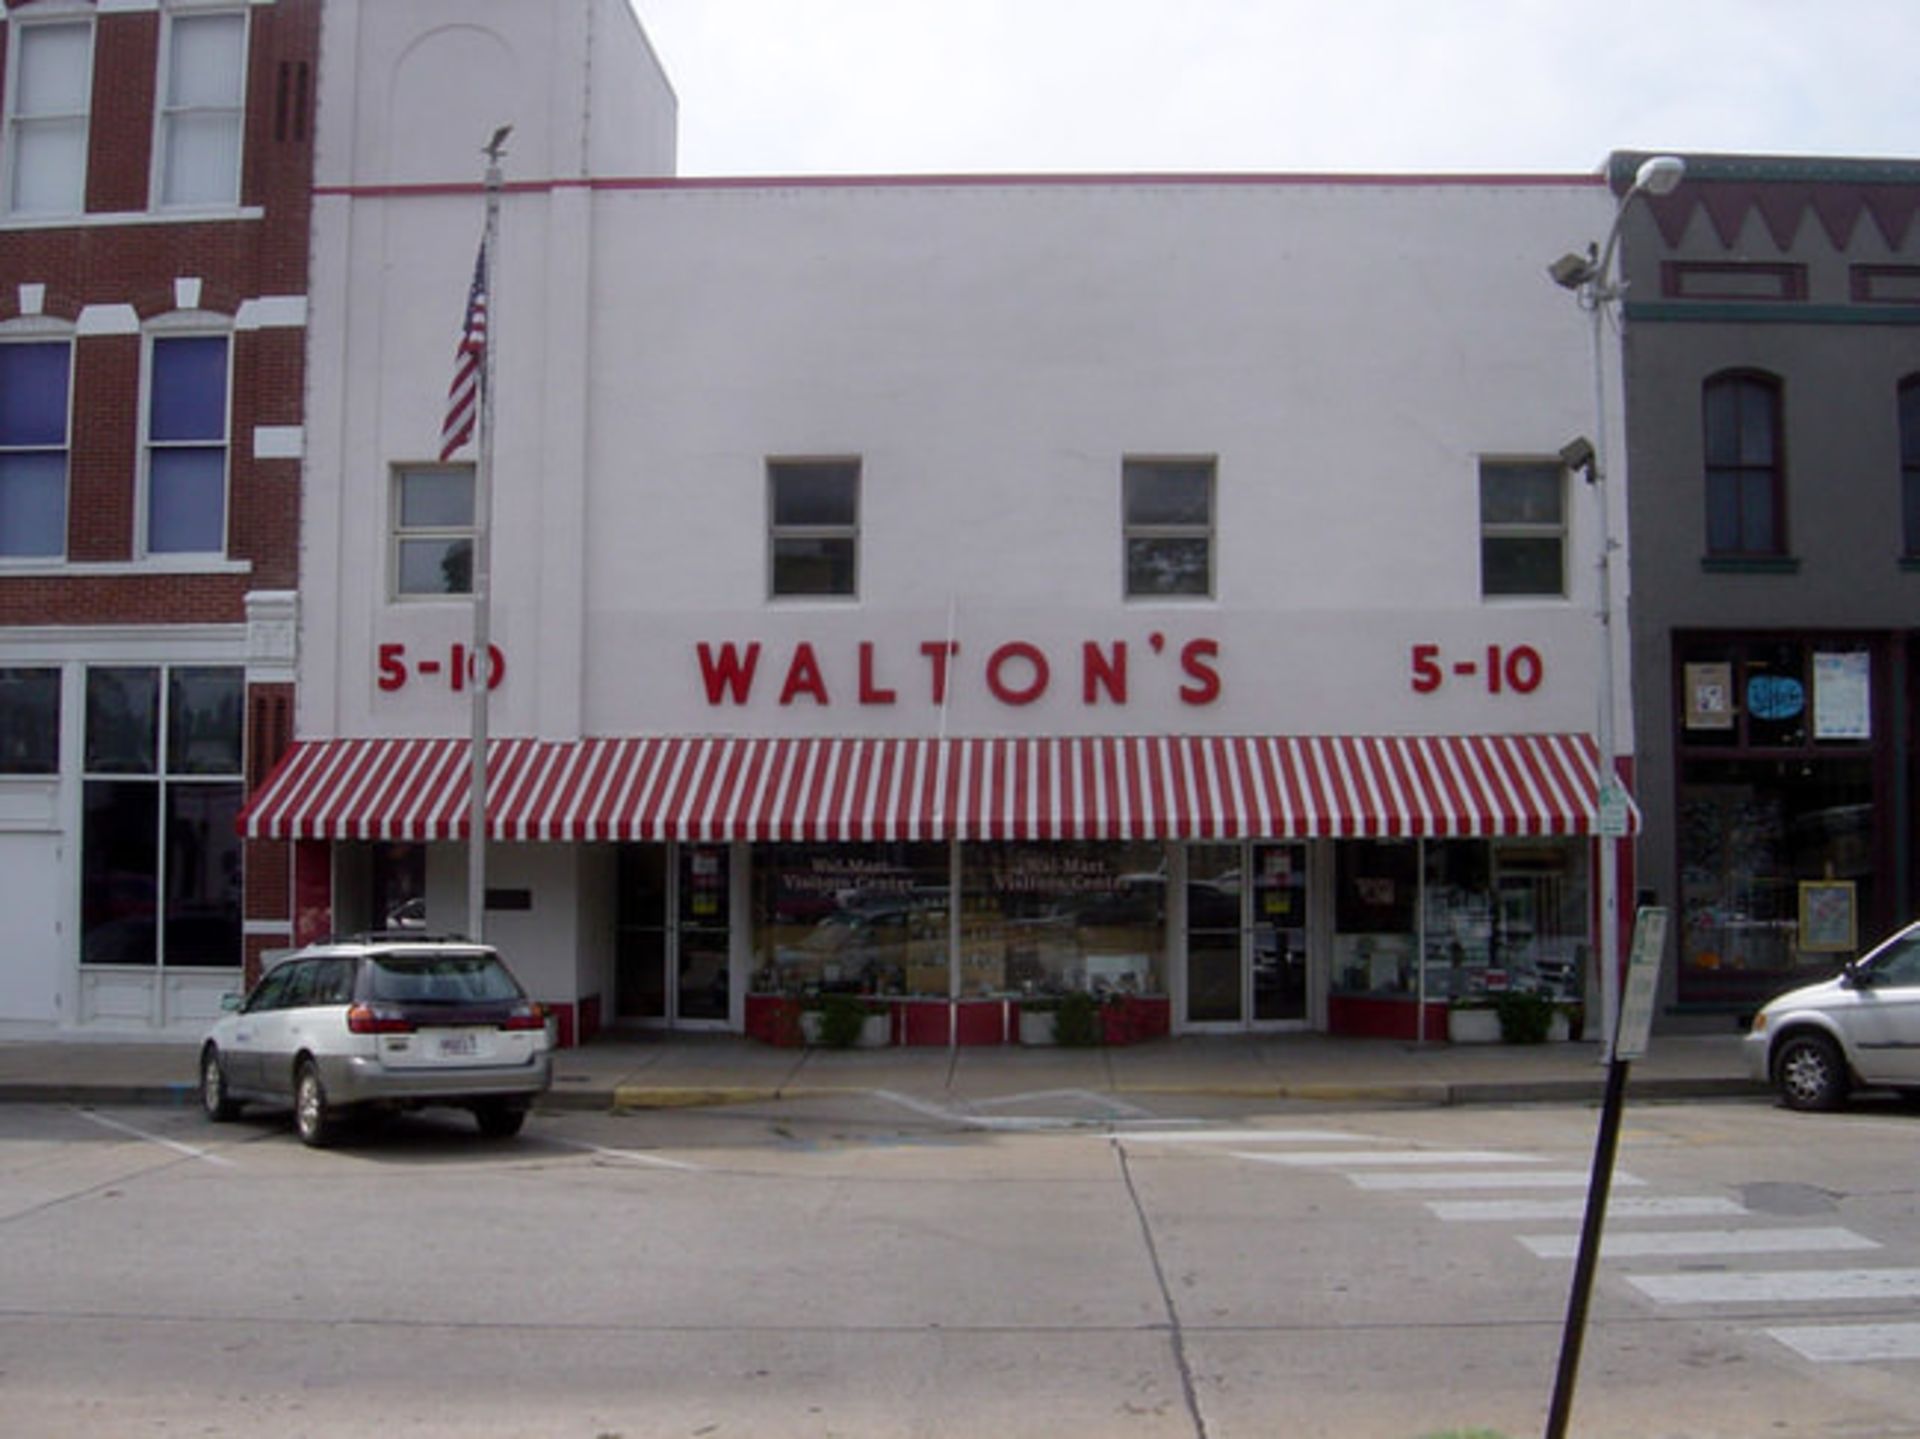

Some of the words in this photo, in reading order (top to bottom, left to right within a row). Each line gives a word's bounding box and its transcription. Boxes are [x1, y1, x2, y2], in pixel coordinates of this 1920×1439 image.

[378, 643, 505, 691] 5-10
[697, 634, 1221, 704] WALTON'S
[1411, 643, 1543, 692] 5-10
